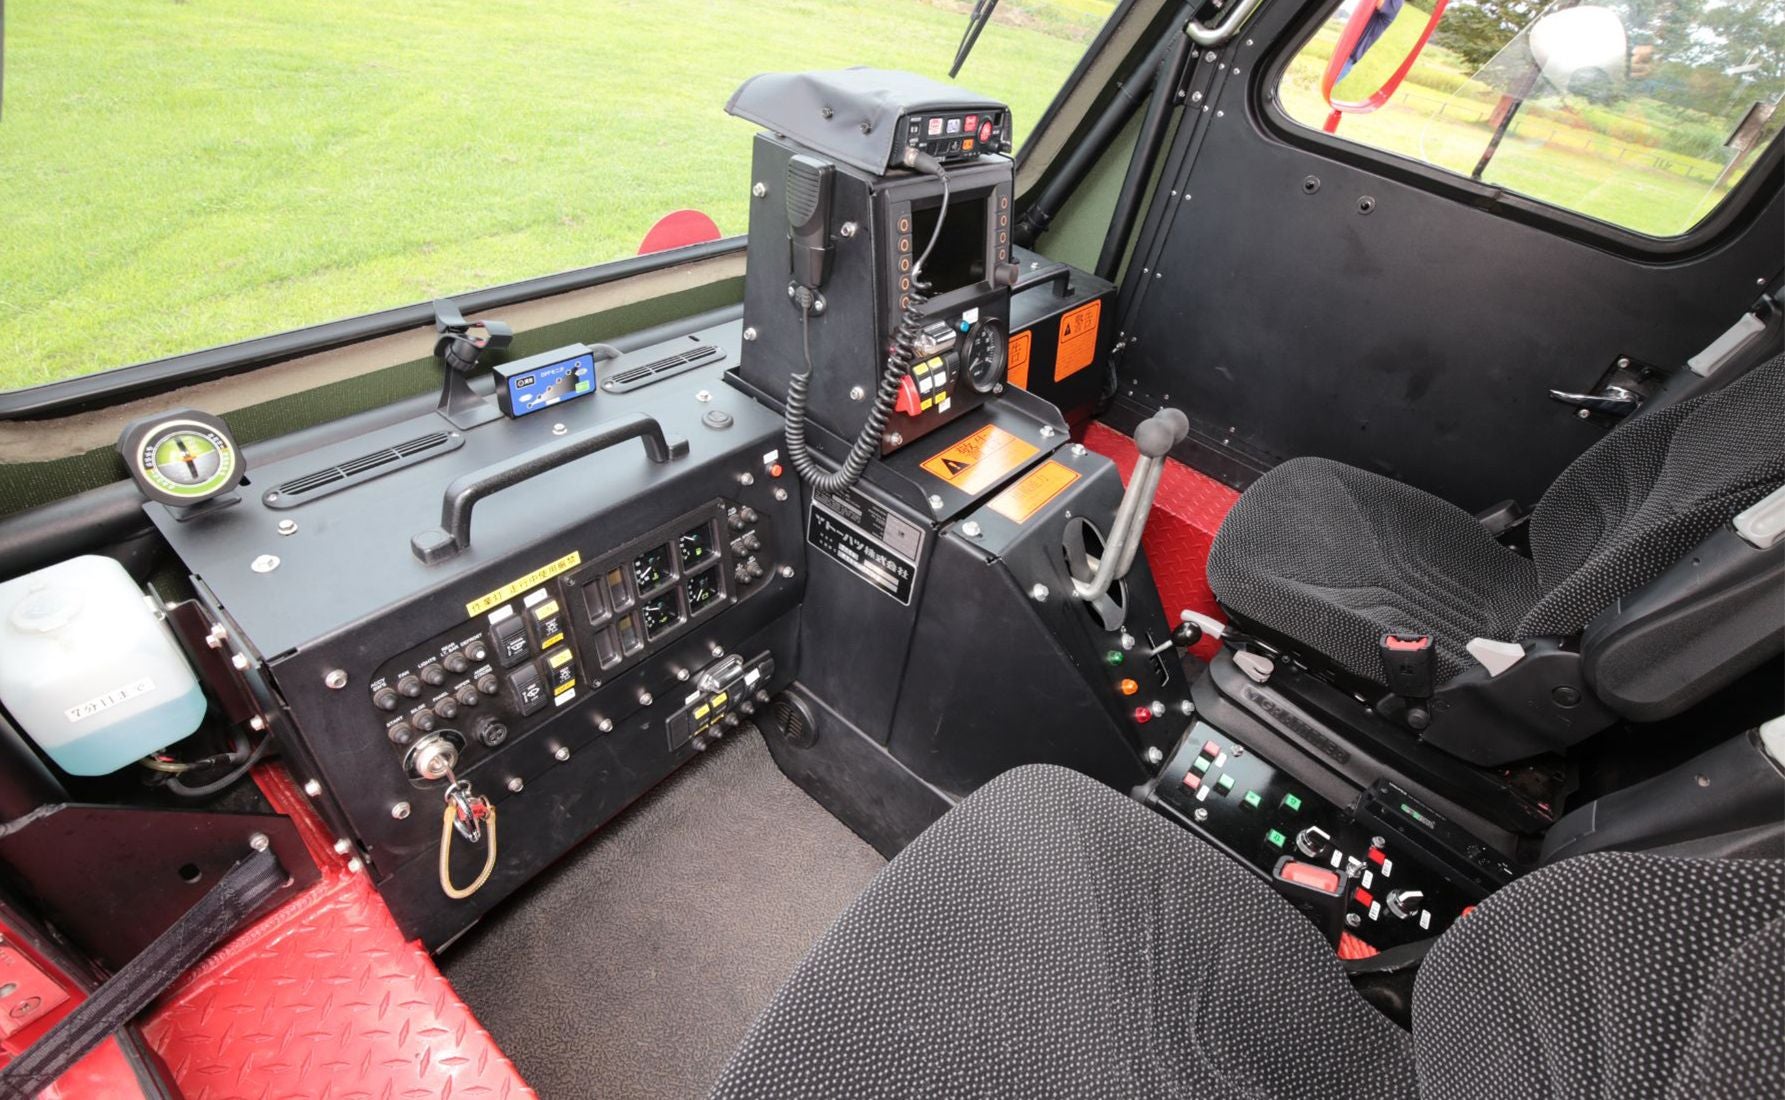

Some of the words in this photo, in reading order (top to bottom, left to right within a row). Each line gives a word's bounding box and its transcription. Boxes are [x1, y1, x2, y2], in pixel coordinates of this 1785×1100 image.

[825, 520, 909, 580] トーハツ株式会社
[460, 632, 483, 647] DEFROST
[440, 642, 456, 651] REAR
[417, 656, 437, 669] LIGHTS
[397, 670, 410, 679] FAN
[454, 679, 471, 690] WIPER
[432, 691, 449, 702] PANEL
[410, 703, 427, 714] BILGE
[386, 715, 404, 728] START
